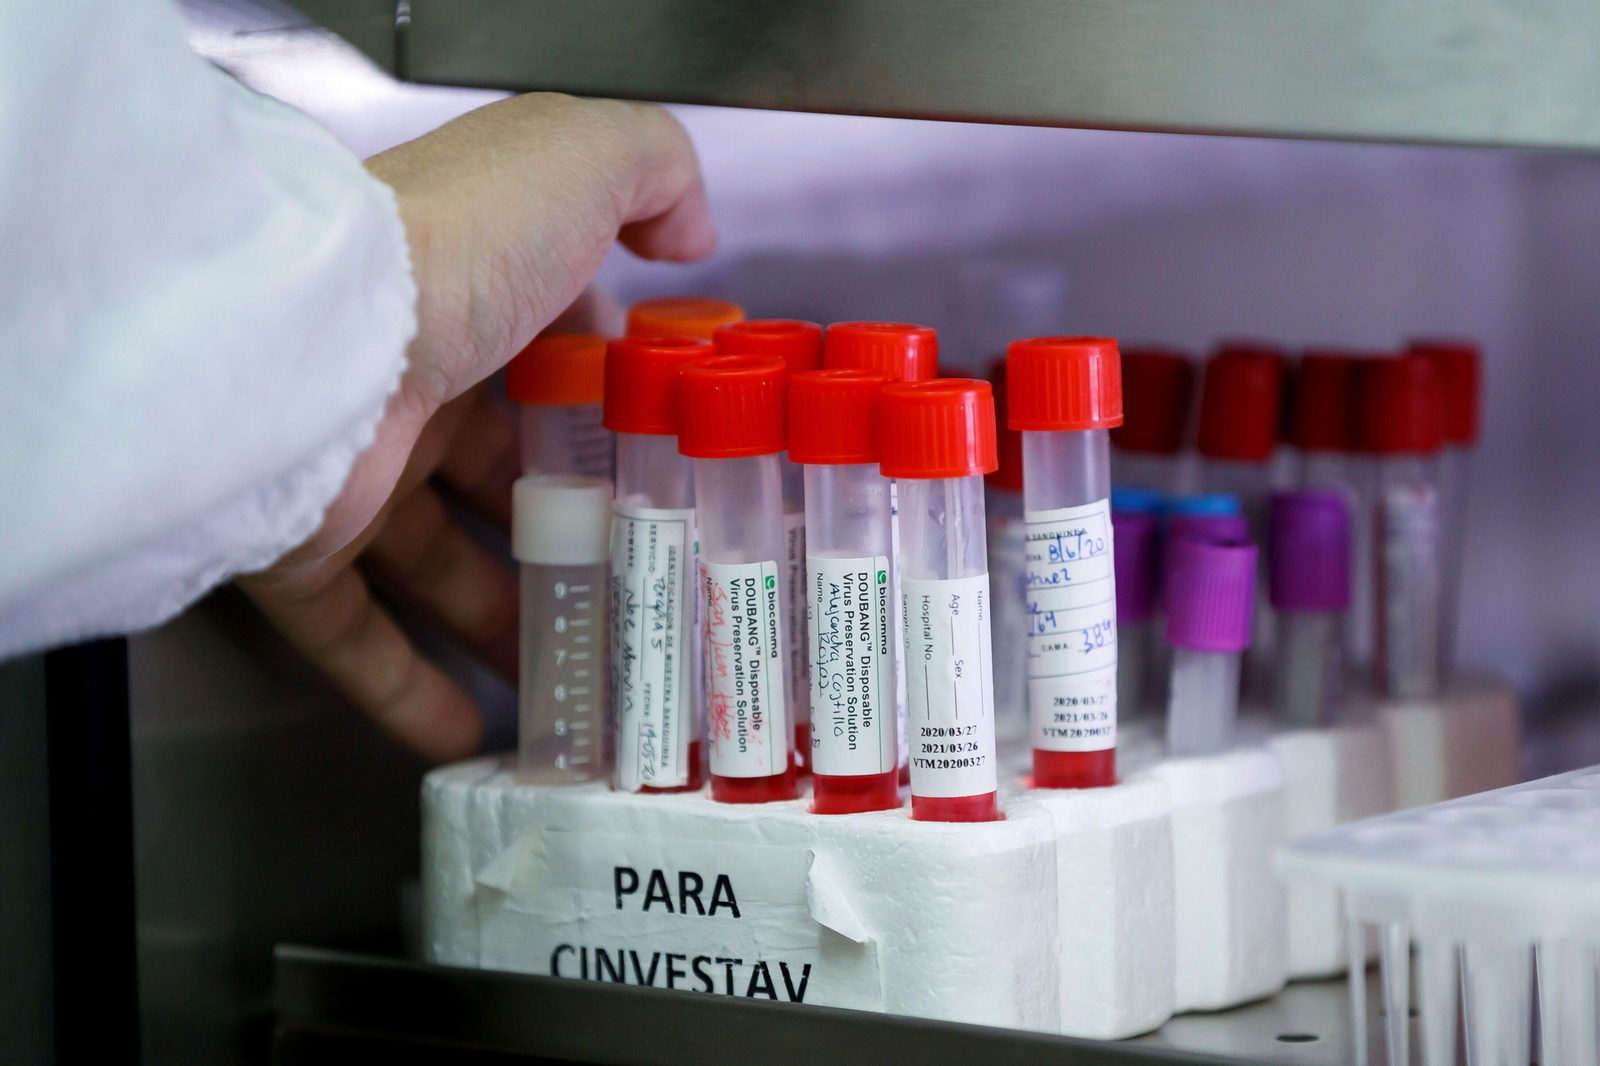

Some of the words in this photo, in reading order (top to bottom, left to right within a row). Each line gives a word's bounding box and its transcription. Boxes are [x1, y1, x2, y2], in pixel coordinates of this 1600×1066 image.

[554, 581, 566, 599] 9
[730, 578, 741, 612] Virus
[842, 572, 853, 606] Virus
[949, 593, 960, 616] Age
[554, 615, 566, 633] 8
[768, 591, 778, 658] biocomma
[879, 586, 887, 655] biocomma
[920, 595, 933, 640] Hospital
[554, 649, 566, 665] 7
[732, 615, 746, 696] Preservation
[816, 632, 830, 689] Rojas
[844, 610, 856, 692] Preservation
[954, 659, 964, 679] Sex
[748, 660, 763, 731] Disposable
[829, 672, 845, 737] Castillo
[859, 656, 873, 727] Disposable
[736, 700, 749, 753] Solution
[847, 696, 859, 750] Solution
[920, 725, 977, 737] 2020/03/27
[1053, 712, 1109, 723] 2021/03/26
[554, 753, 566, 769] 4
[913, 755, 986, 769] VTM20200327
[921, 741, 979, 753] 2021/03/26
[614, 867, 741, 918] PARA
[550, 944, 812, 1004] CINVESTAV
